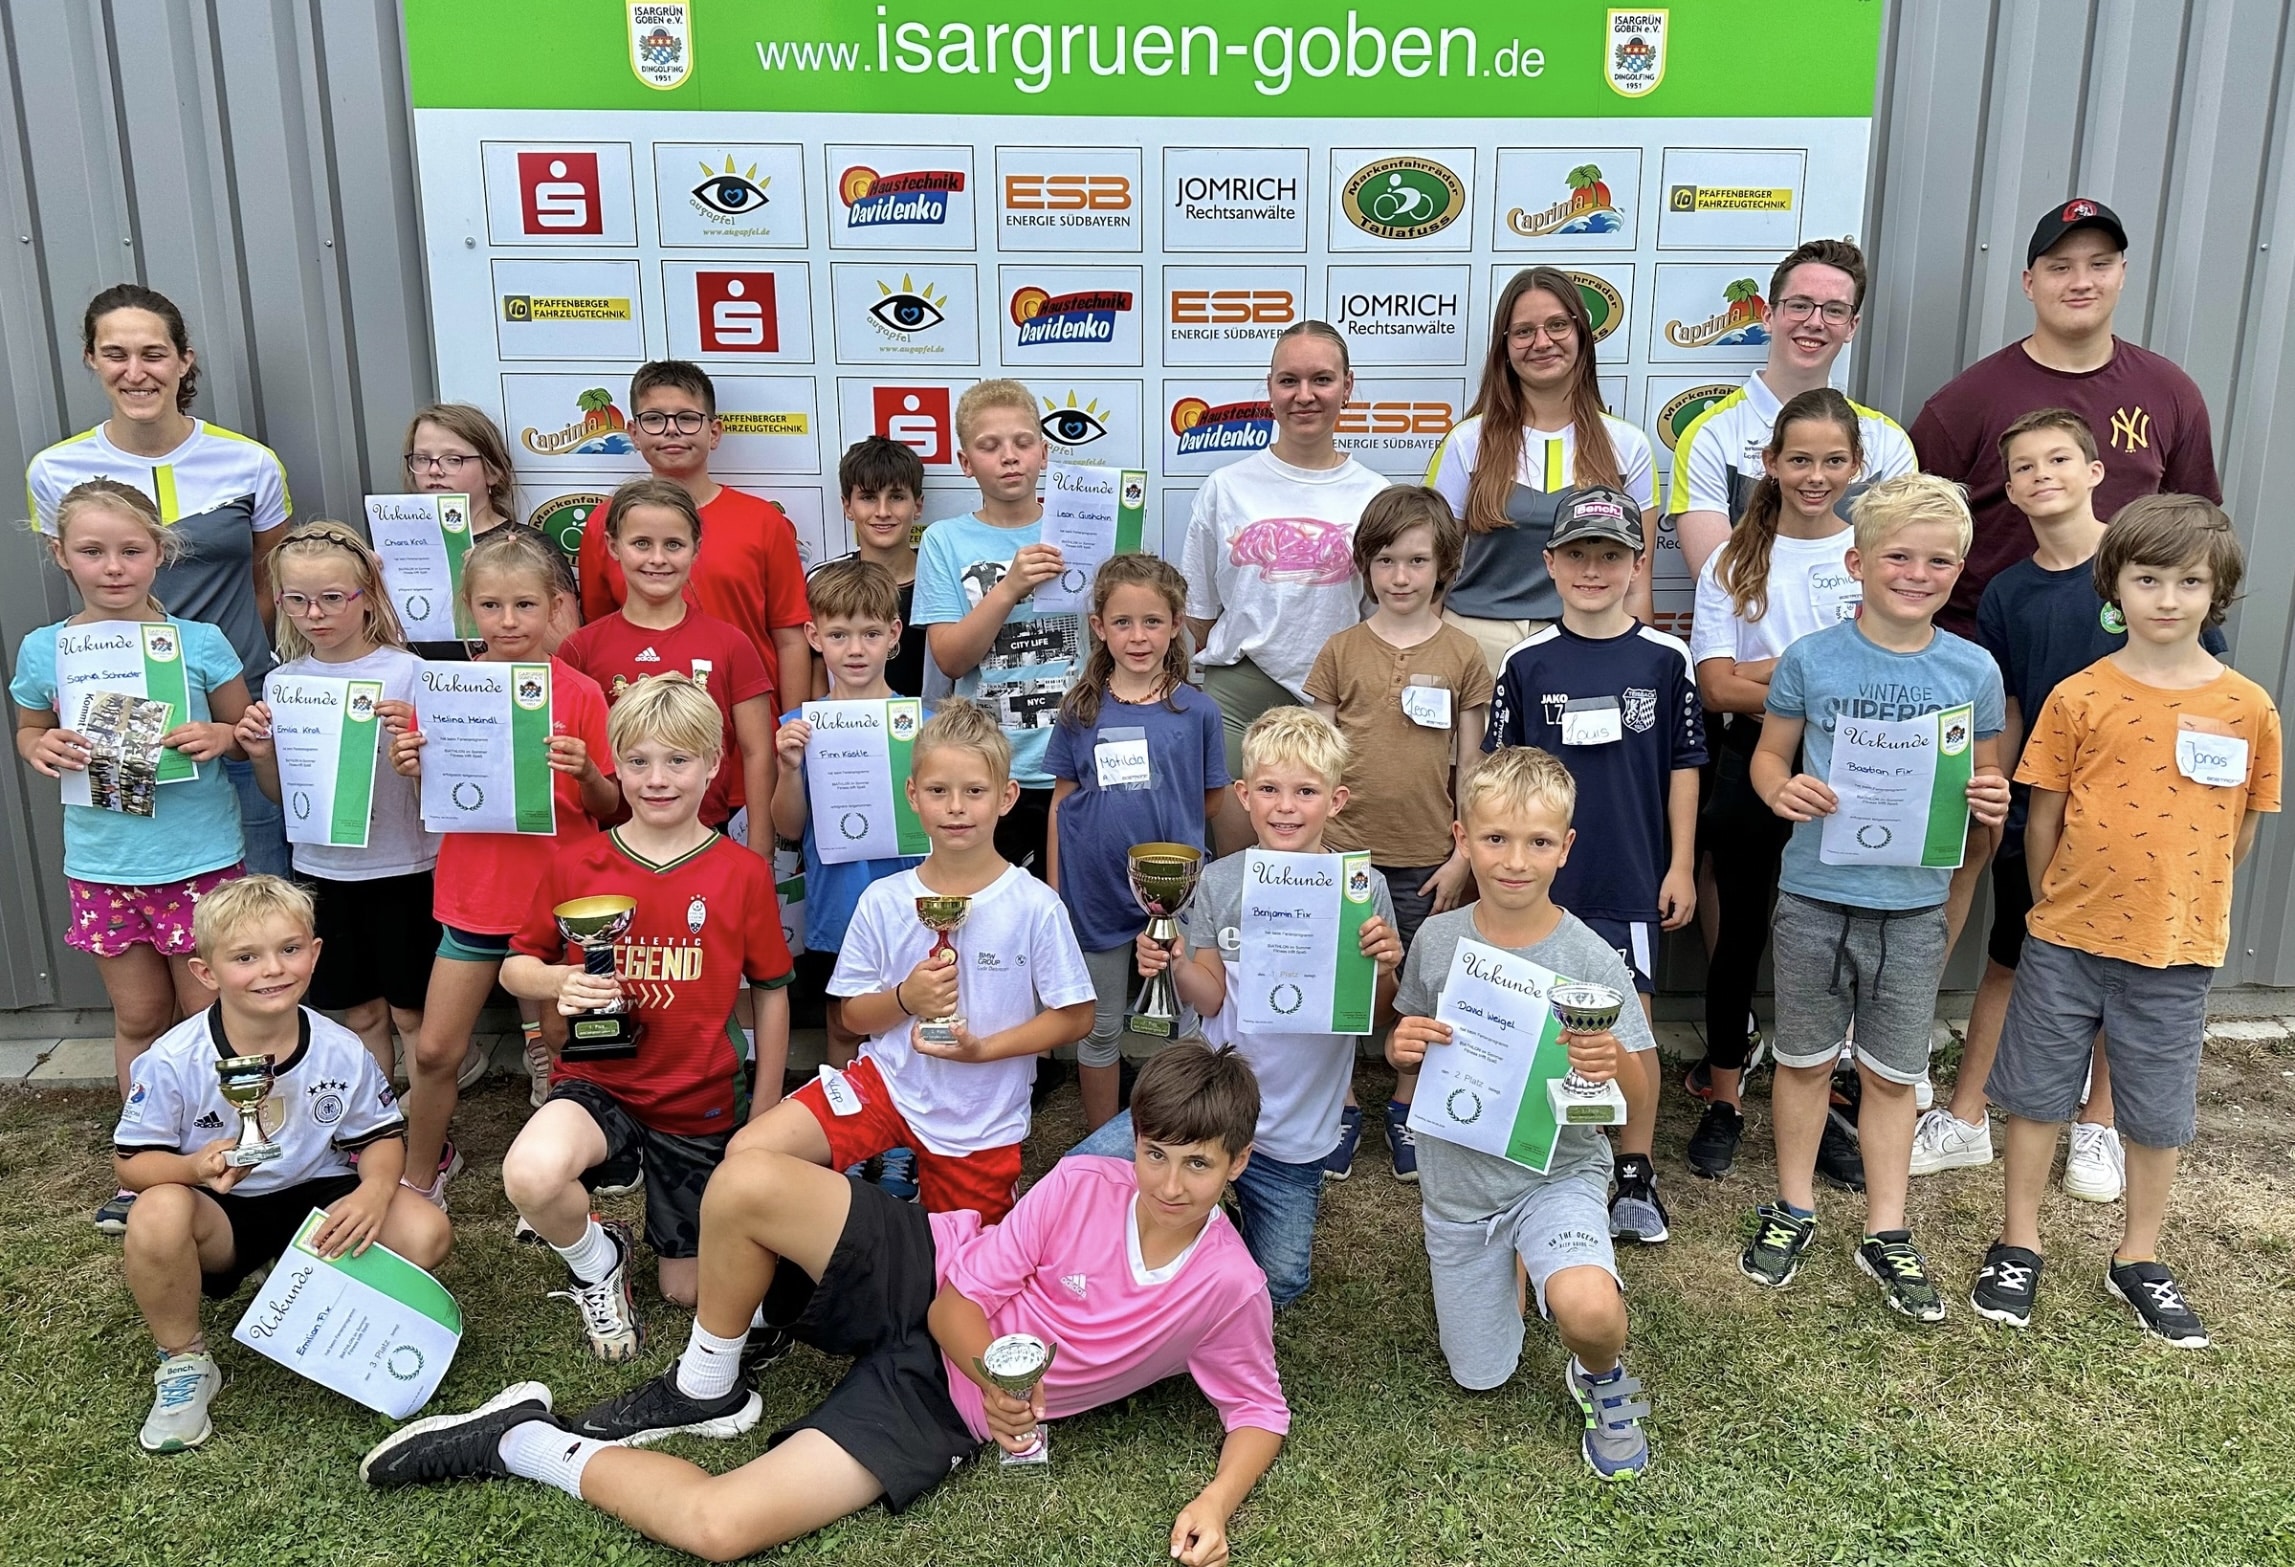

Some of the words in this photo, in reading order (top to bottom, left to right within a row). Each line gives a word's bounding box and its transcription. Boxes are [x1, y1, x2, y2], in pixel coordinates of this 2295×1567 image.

[634, 5, 684, 16] ISARGRÜN
[635, 16, 665, 24] GOBEN
[1614, 14, 1662, 25] ISARGRÜN
[1614, 25, 1643, 33] GOBEN
[756, 5, 1546, 96] www.isargruen-goben.de
[870, 173, 960, 196] Haustechnik
[1348, 160, 1459, 196] Markenfahrräder
[1005, 175, 1132, 210] ESB
[1175, 177, 1297, 207] JOMRICH
[1699, 189, 1773, 199] PFAFFENBERGER
[689, 198, 736, 226] augapfel
[850, 194, 943, 224] Davidenko
[1185, 204, 1296, 221] Rechtsanwälte
[1513, 193, 1585, 231] Caprima
[1698, 200, 1787, 210] FAHRZEUGTECHNIK
[1005, 214, 1056, 228] ENERGIE
[1059, 212, 1131, 228] SÜDBAYERN
[1360, 215, 1450, 238] Tallafuss
[703, 228, 771, 238] www.augapfel.de
[533, 299, 610, 308] PFAFFENBERGER
[534, 309, 626, 319] FAHRZEUGTECHNIK
[1038, 293, 1125, 317] Haustechnik
[1171, 291, 1295, 323] ESB
[1338, 294, 1457, 323] JOMRICH
[866, 315, 912, 343] augapfel
[1021, 313, 1110, 342] Davidenko
[1171, 329, 1220, 341] ENERGIE
[1223, 327, 1288, 340] SÜDBAYER
[1348, 320, 1456, 335] Rechtsanwälte
[1671, 307, 1742, 343] Caprima
[879, 345, 945, 354] www.augapfel.de
[723, 424, 803, 433] HRZEUGTECHNIK
[1334, 402, 1453, 433] ESB
[529, 416, 600, 451] Caprima
[1180, 422, 1268, 452] Davidenko
[1332, 438, 1380, 449] ENERGIE
[1383, 437, 1442, 449] SÜDBAYER
[1053, 471, 1115, 495] Urkunde
[372, 504, 433, 521] Urkunde
[59, 634, 135, 657] Urkunde
[1010, 640, 1030, 650] CITY
[1031, 638, 1049, 647] LIFE
[421, 670, 503, 693] Urkunde
[1858, 682, 1933, 704] VINTAGE
[272, 684, 339, 706] Urkunde
[1026, 697, 1046, 706] NYC
[1540, 693, 1568, 704] JAKO
[77, 693, 95, 727] Kommt
[432, 713, 465, 724] Melina
[809, 711, 880, 731] Urkunde
[1822, 697, 1959, 733] SUPERIO
[1843, 726, 1930, 750] Urkunde
[2181, 740, 2228, 774] Jonas
[1252, 861, 1334, 887] Urkunde
[624, 936, 702, 946] HLETIC
[614, 945, 704, 981] EGEND
[1462, 952, 1543, 999] Urkunde
[1463, 1074, 1485, 1088] Platz
[194, 1121, 224, 1129] adidas
[249, 1265, 314, 1339] Urkunde
[375, 1339, 390, 1360] Platz
